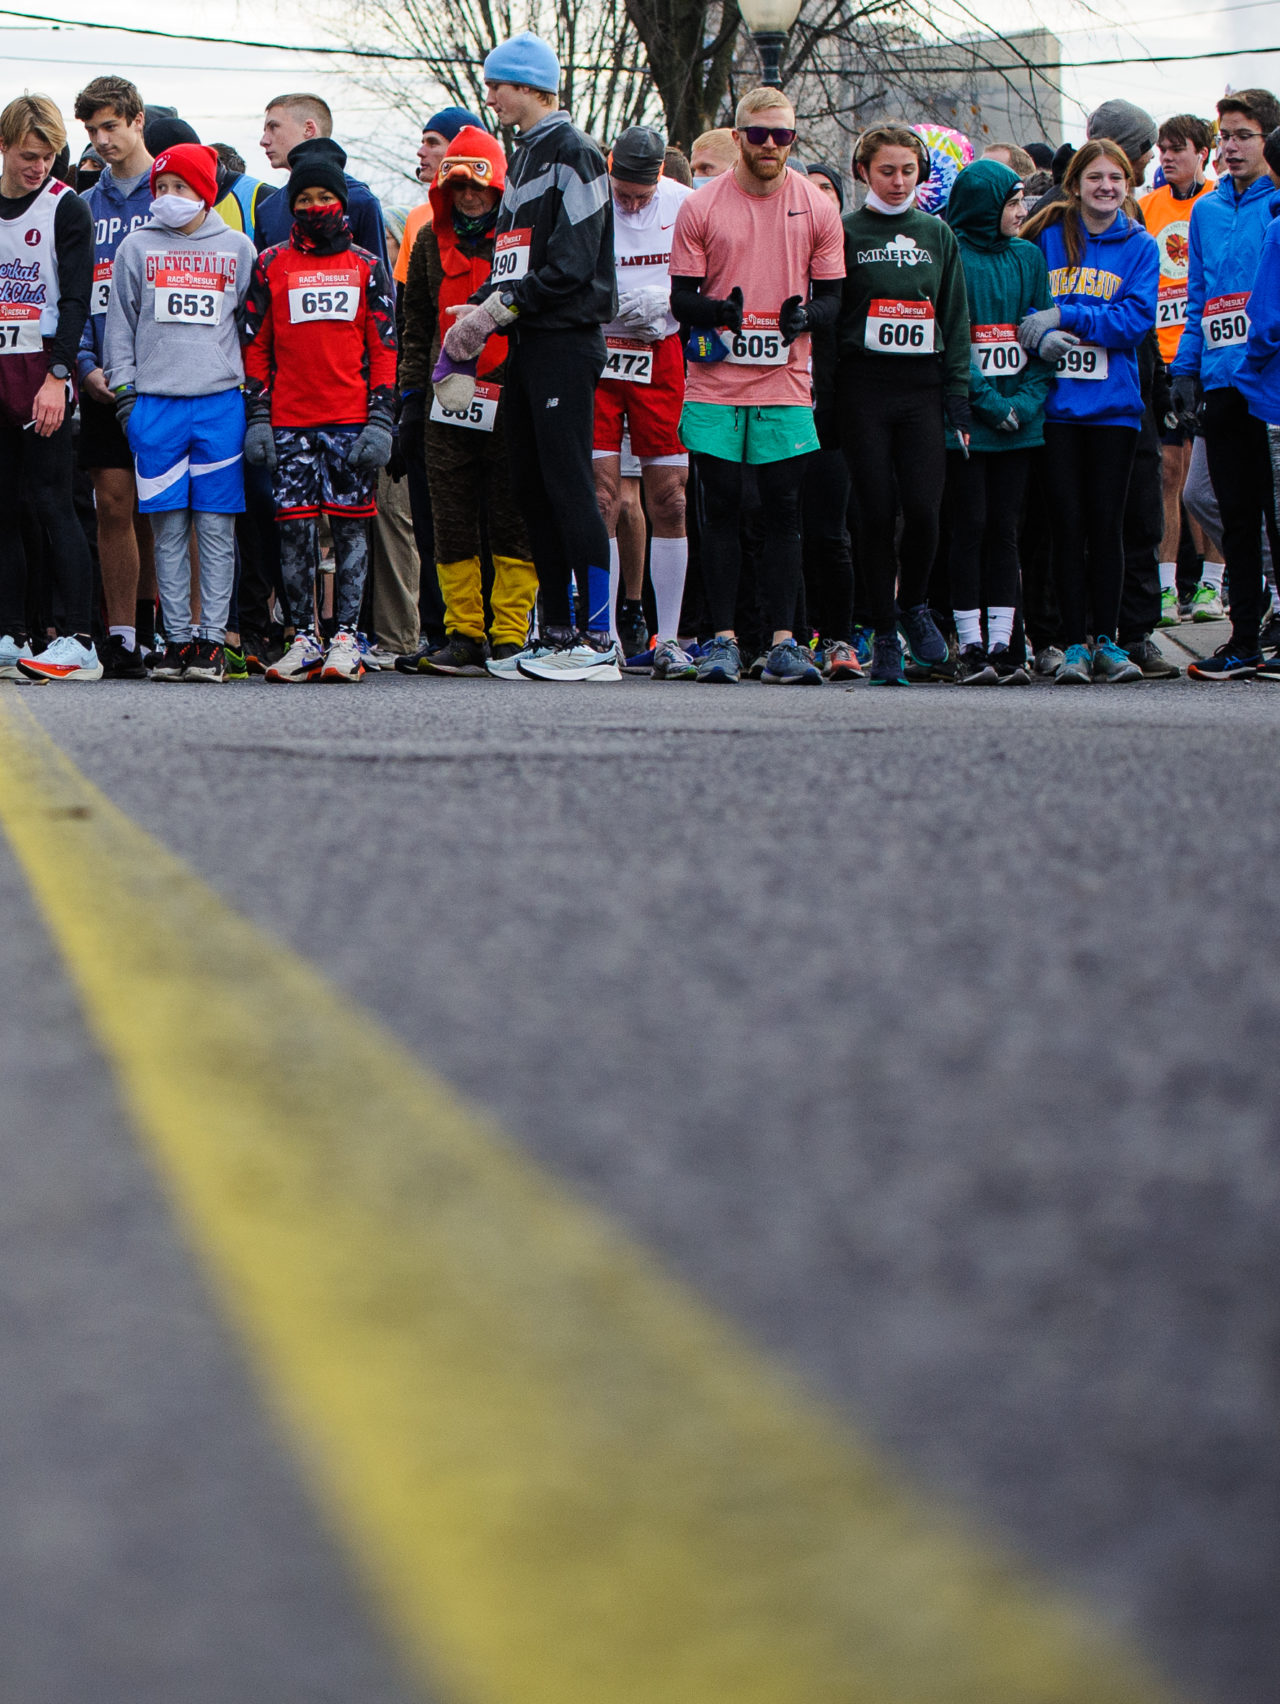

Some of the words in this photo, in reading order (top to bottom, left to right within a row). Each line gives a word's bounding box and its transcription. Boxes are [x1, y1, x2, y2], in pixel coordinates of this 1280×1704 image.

[857, 248, 933, 264] MINERVA
[166, 275, 185, 284] RACE
[12, 282, 46, 304] Club
[302, 291, 348, 314] 652
[168, 293, 214, 317] 653
[904, 307, 927, 315] RESULT
[879, 324, 924, 346] 606
[1210, 315, 1247, 342] 650
[732, 335, 779, 358] 605
[606, 353, 650, 377] 472
[978, 347, 1020, 370] 700
